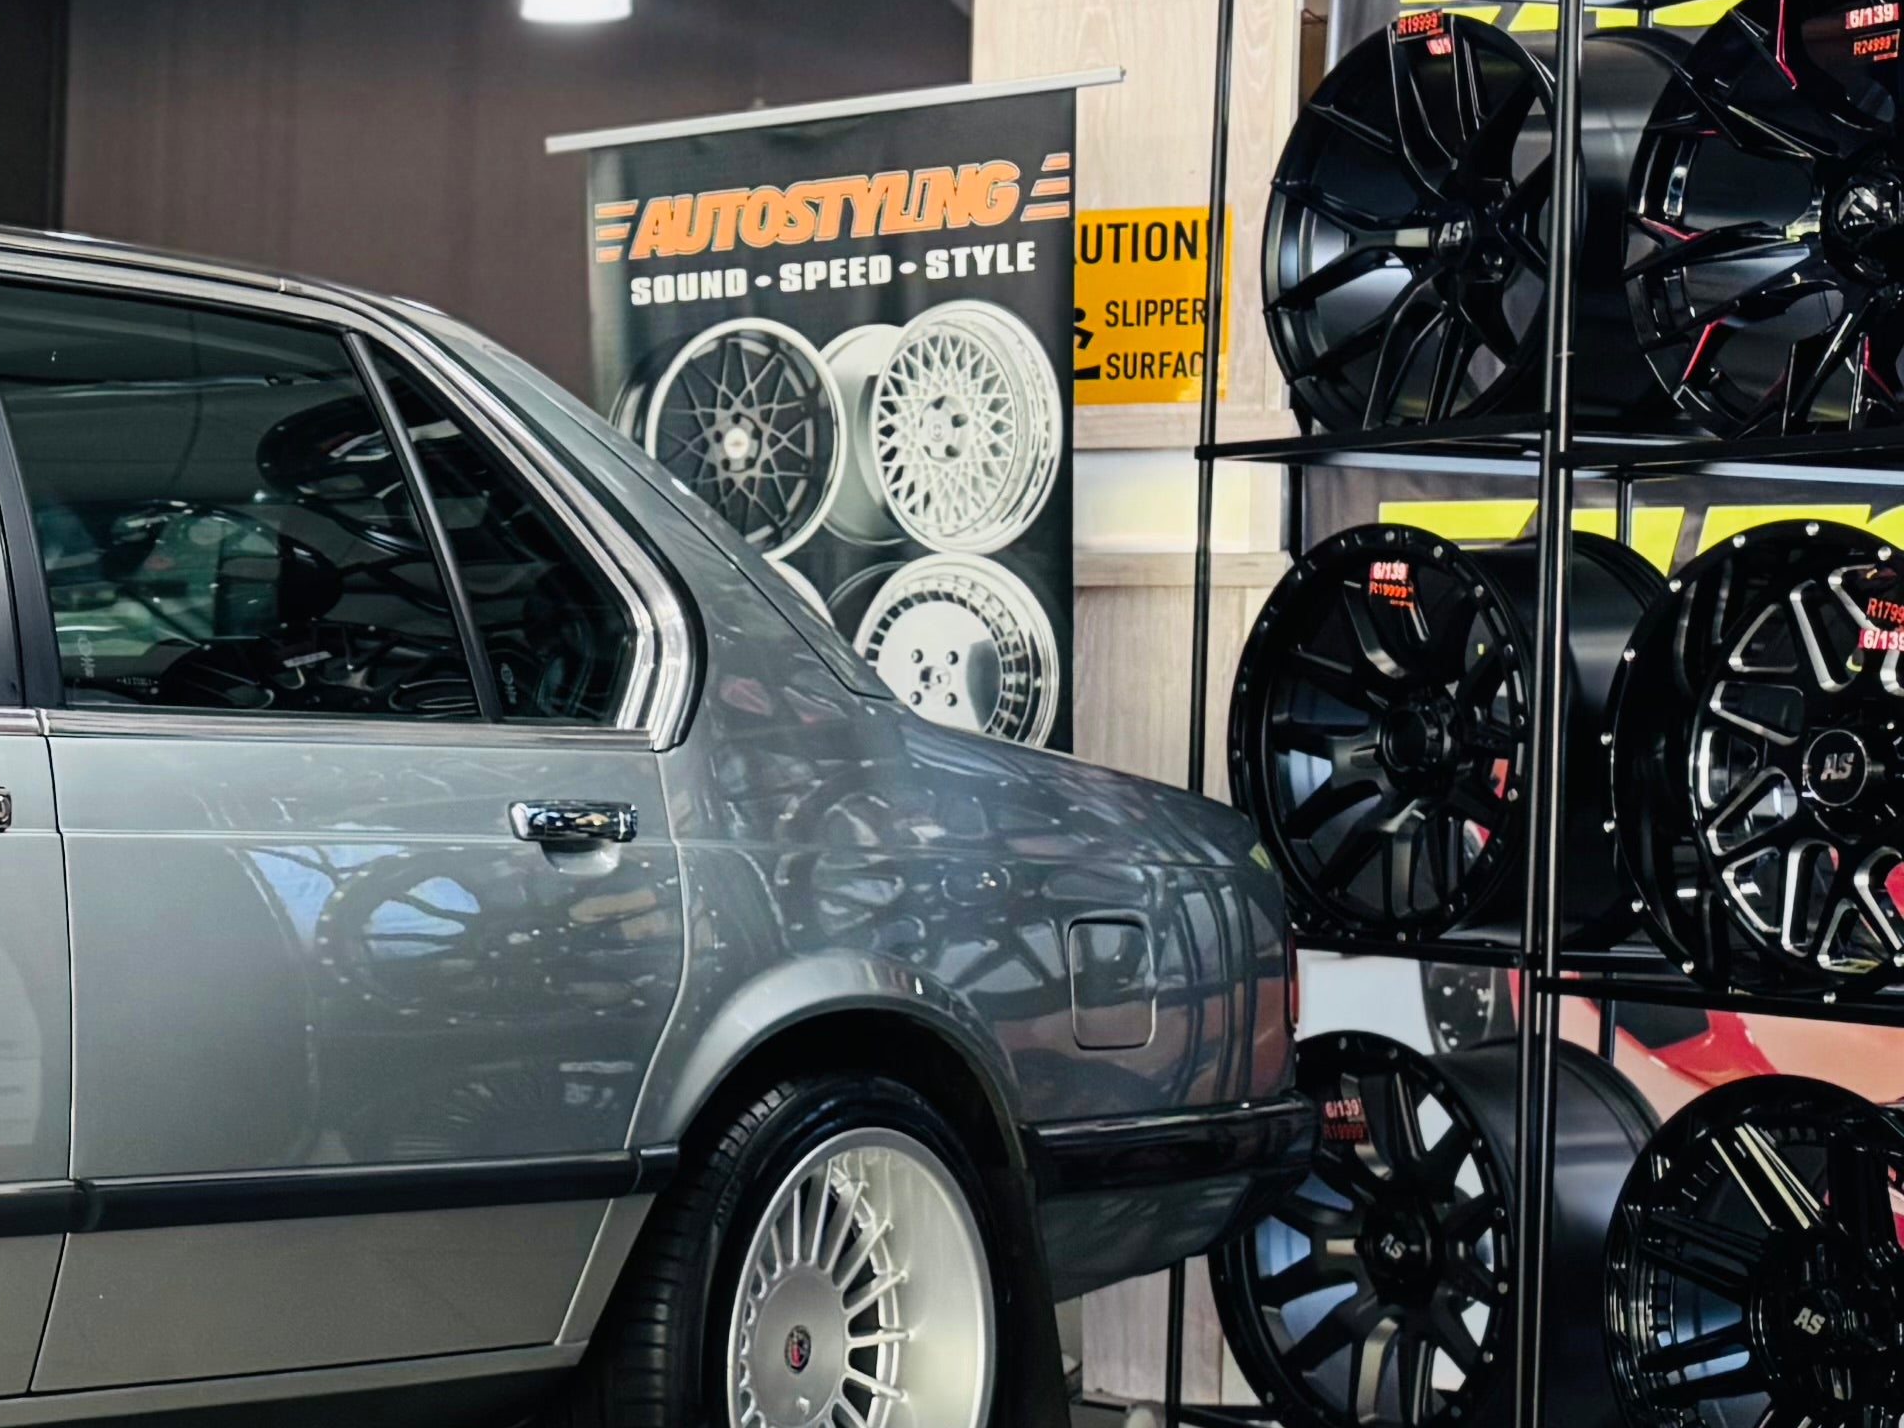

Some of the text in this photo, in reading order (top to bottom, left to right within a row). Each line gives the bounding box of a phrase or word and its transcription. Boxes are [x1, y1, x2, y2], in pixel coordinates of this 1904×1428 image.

[1849, 3, 1894, 29] 6/139
[628, 159, 1021, 261] AUTOSTYLING
[1072, 219, 1211, 266] UTION
[1438, 221, 1466, 247] AS
[630, 241, 1037, 306] SOUND SPEED STYLE
[1104, 298, 1206, 328] SLIPPER
[1105, 351, 1205, 380] SURFAC
[1821, 752, 1855, 781] AS
[1793, 1307, 1826, 1335] AS
